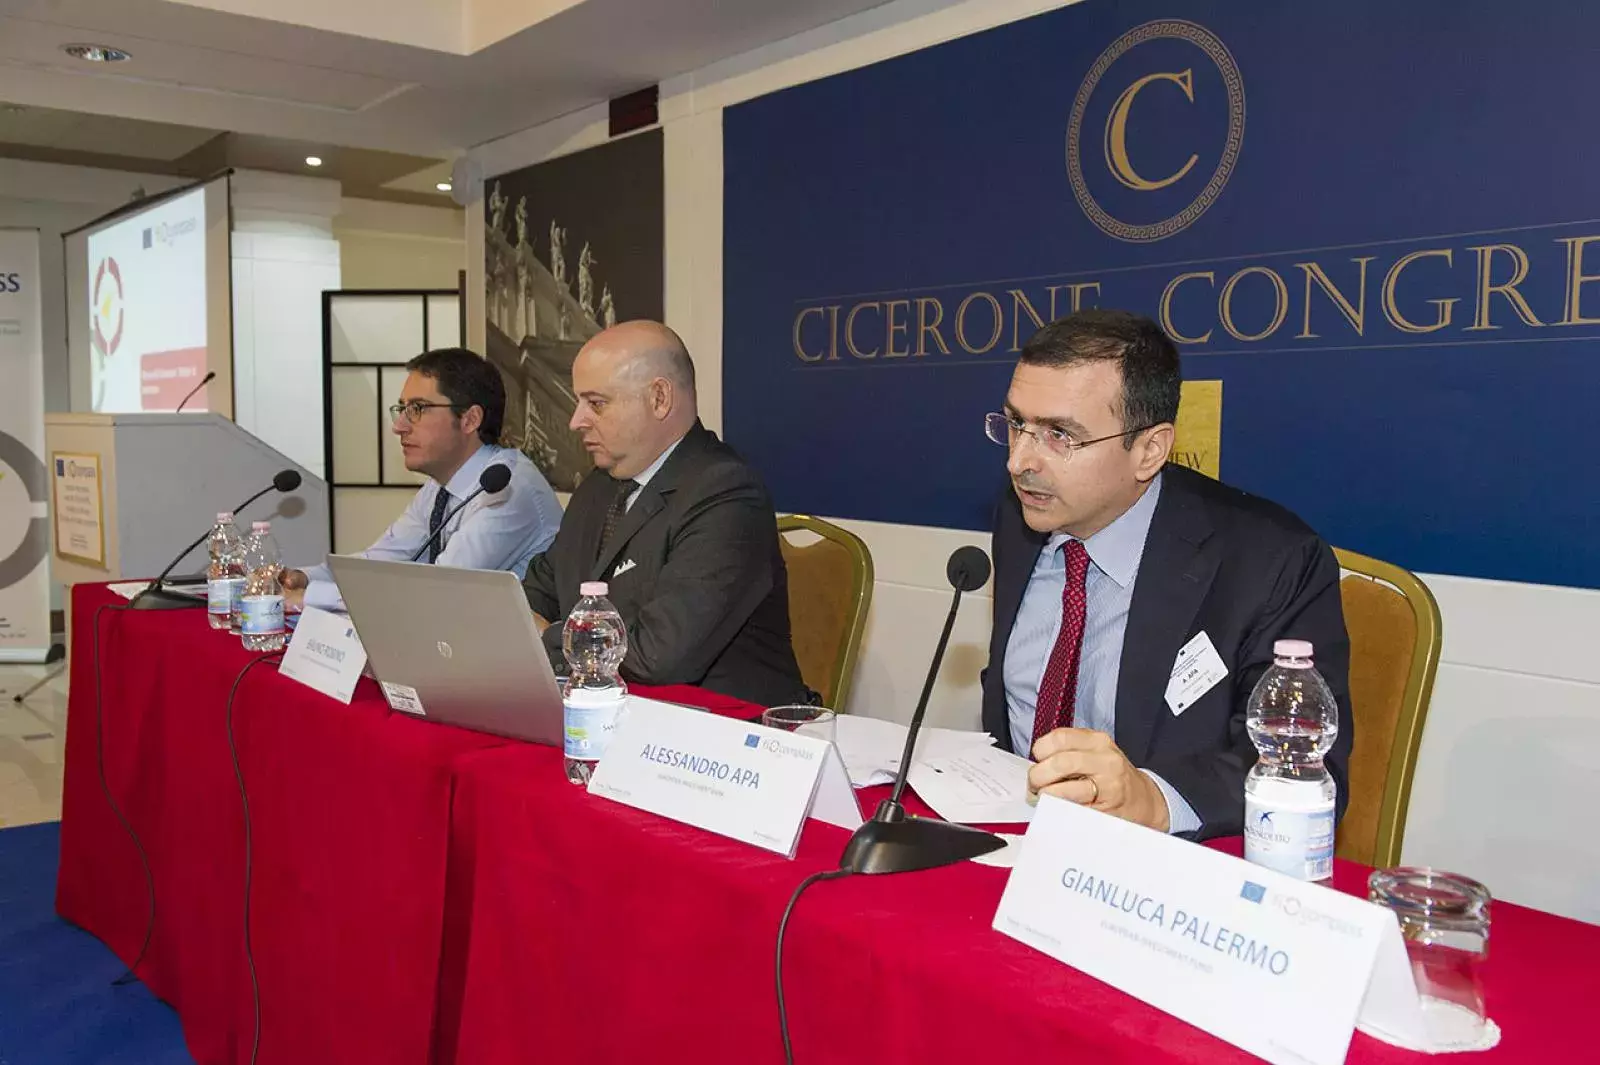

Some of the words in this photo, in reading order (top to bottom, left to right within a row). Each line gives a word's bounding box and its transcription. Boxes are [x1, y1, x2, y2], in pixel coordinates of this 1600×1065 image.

[1104, 67, 1200, 190] C
[640, 743, 730, 780] ALESSANDRO
[729, 767, 761, 790] APA
[1060, 867, 1166, 928] GIANLUCA
[1170, 910, 1290, 976] PALERMO
